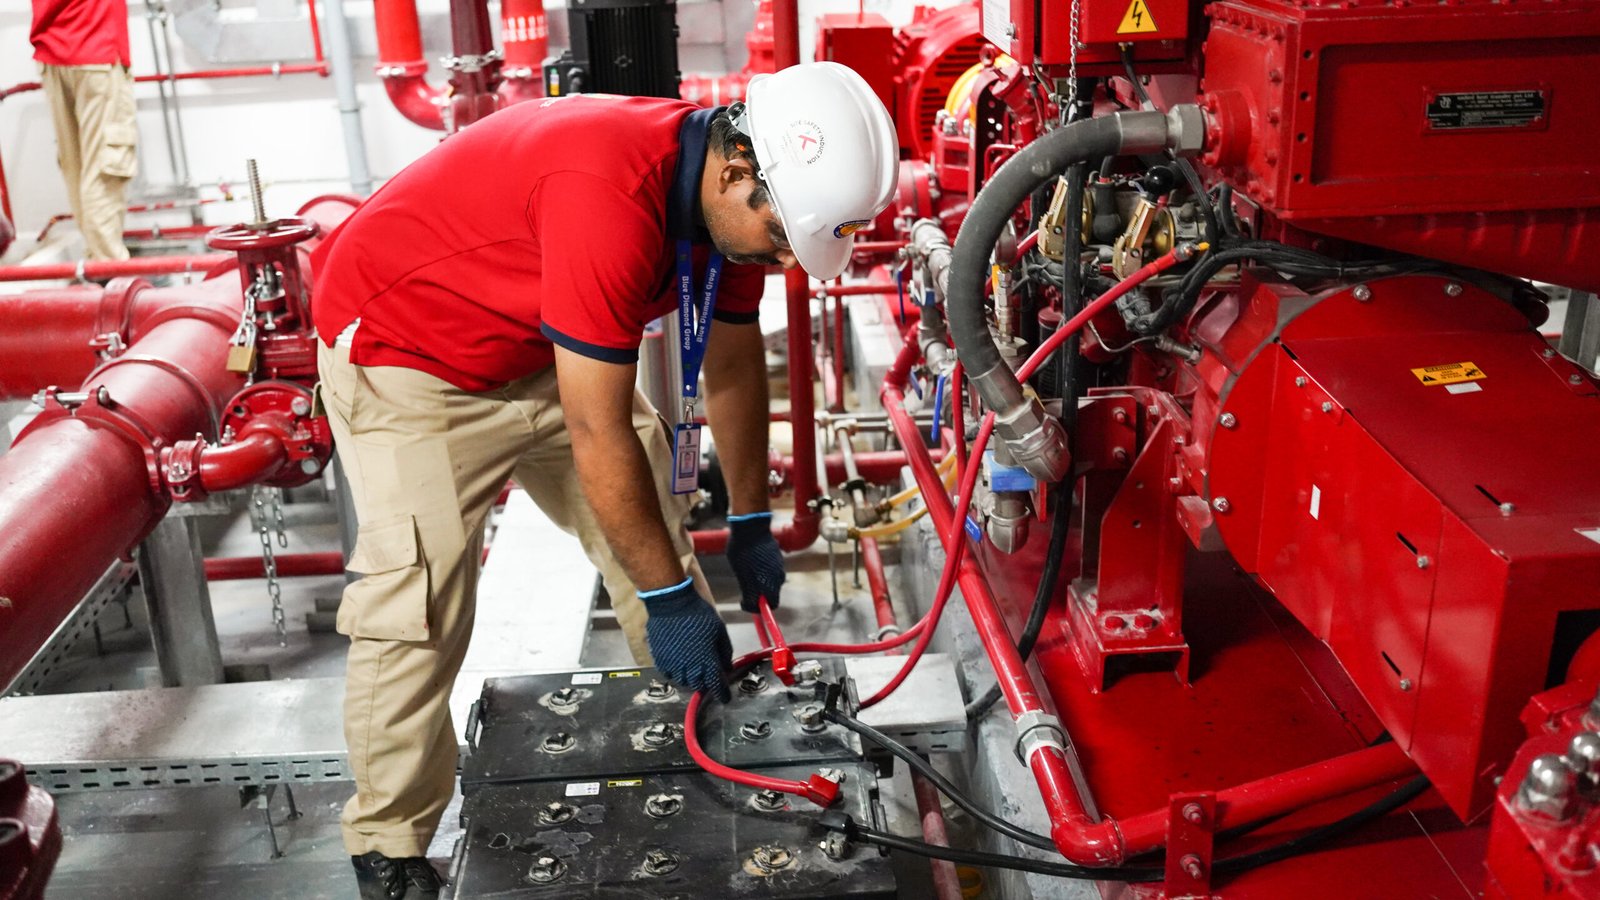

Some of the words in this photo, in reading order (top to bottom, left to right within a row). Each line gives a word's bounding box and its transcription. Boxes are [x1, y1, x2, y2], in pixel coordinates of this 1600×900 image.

[803, 120, 822, 134] SAFETY
[806, 135, 825, 165] INDUCTION
[681, 276, 689, 293] Blue
[705, 268, 717, 290] Group
[682, 295, 691, 327] Diamond
[699, 292, 712, 324] Diamond
[683, 328, 691, 351] Group
[696, 326, 705, 343] Blue
